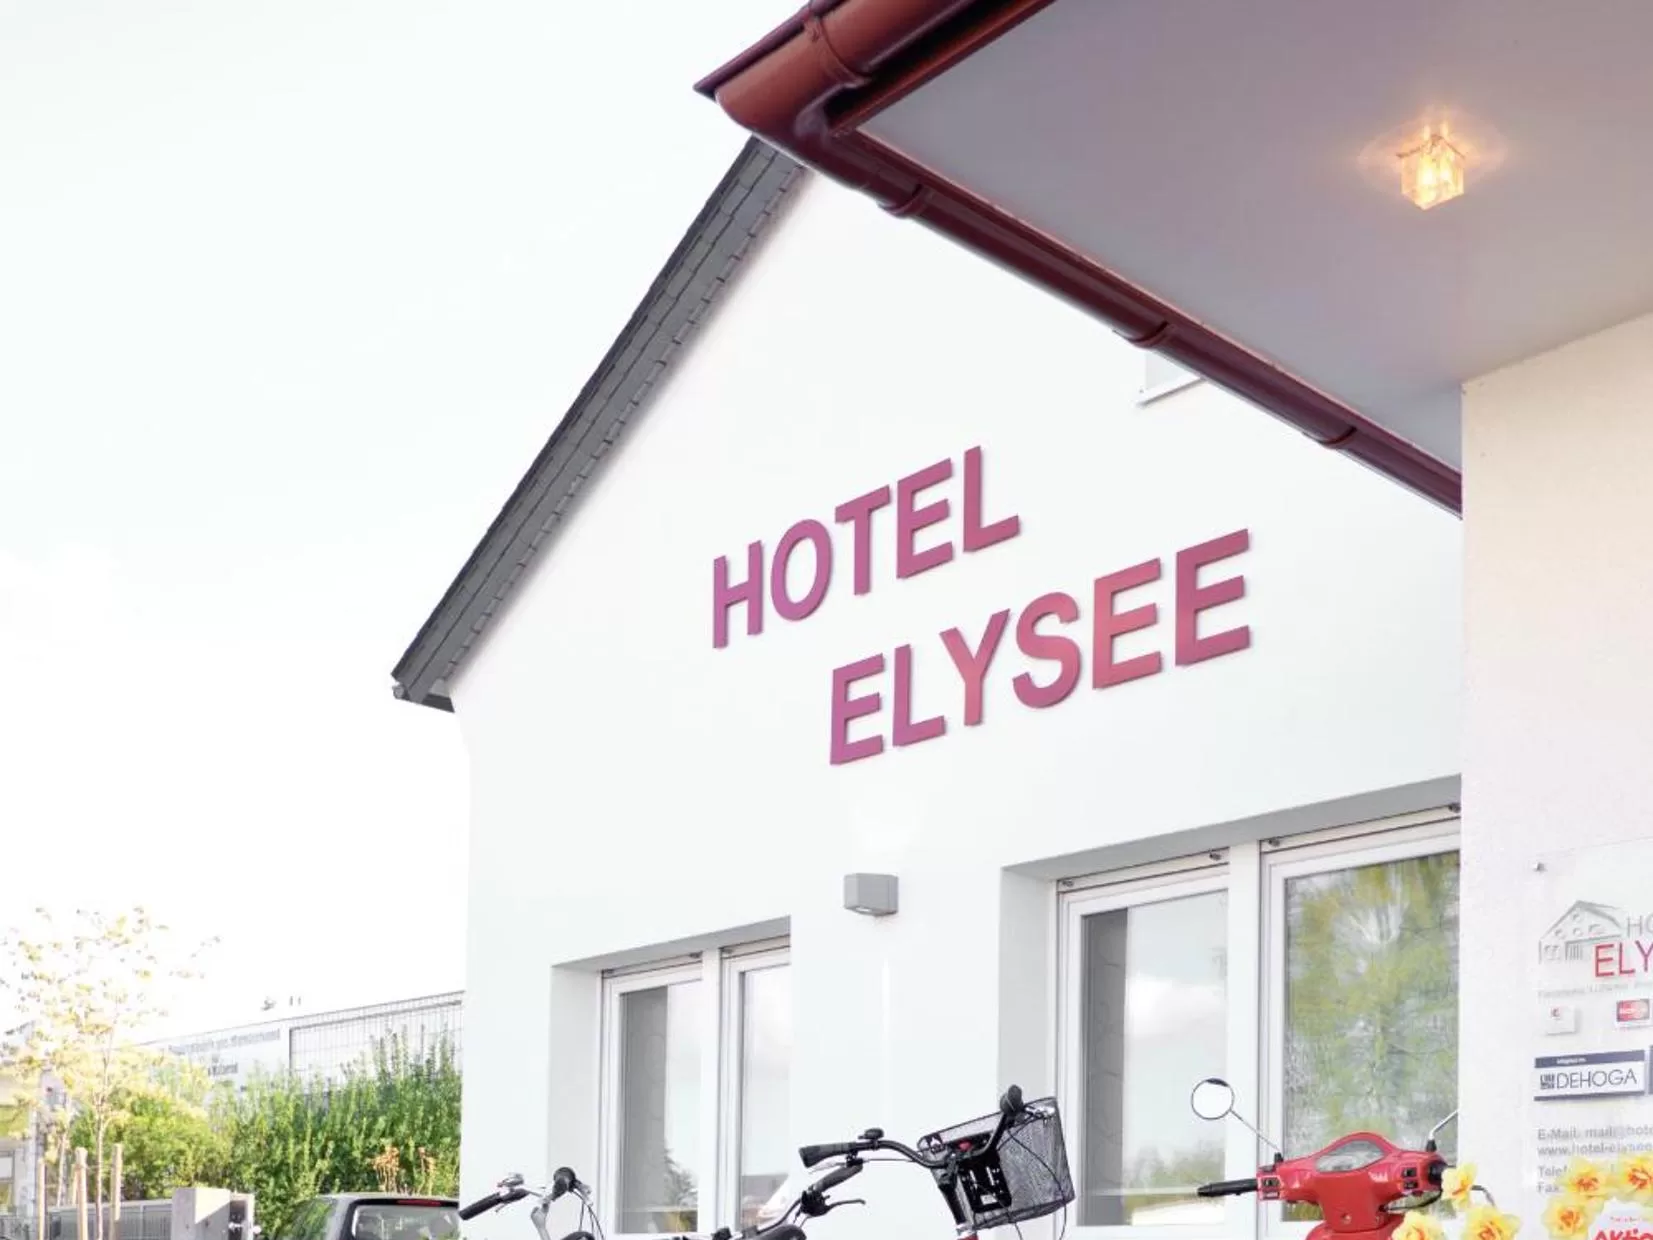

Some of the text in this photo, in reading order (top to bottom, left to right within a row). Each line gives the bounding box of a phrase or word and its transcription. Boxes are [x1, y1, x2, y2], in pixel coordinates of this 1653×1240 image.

[712, 444, 1020, 649] HOTEL
[829, 527, 1251, 767] ELYSEE
[1556, 1068, 1638, 1090] DEHOGA
